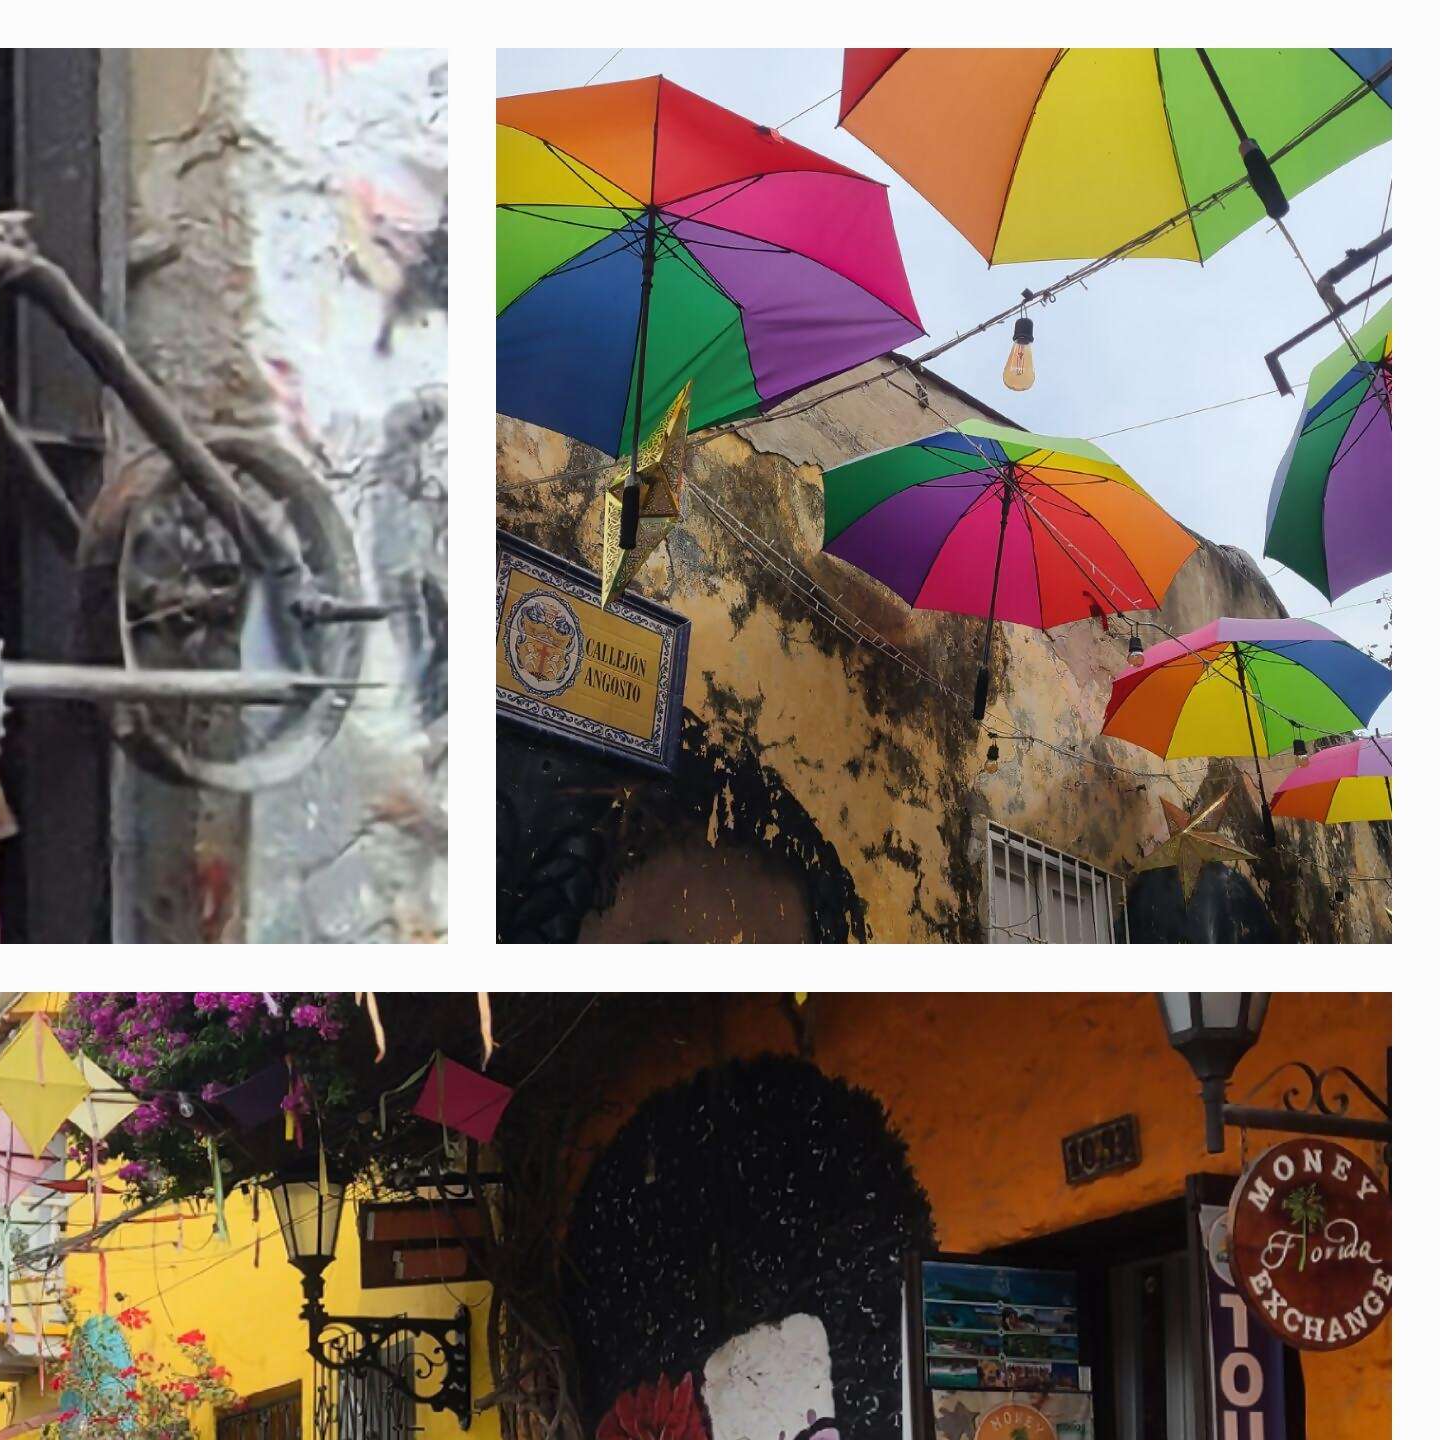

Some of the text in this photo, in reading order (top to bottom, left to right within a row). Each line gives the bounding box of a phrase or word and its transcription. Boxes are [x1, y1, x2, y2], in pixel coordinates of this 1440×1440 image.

[586, 637, 646, 678] CALLEJÓN
[584, 667, 641, 703] ANGOSTO
[1248, 1147, 1379, 1212] MONEY
[1249, 1268, 1392, 1343] EXCHANGE
